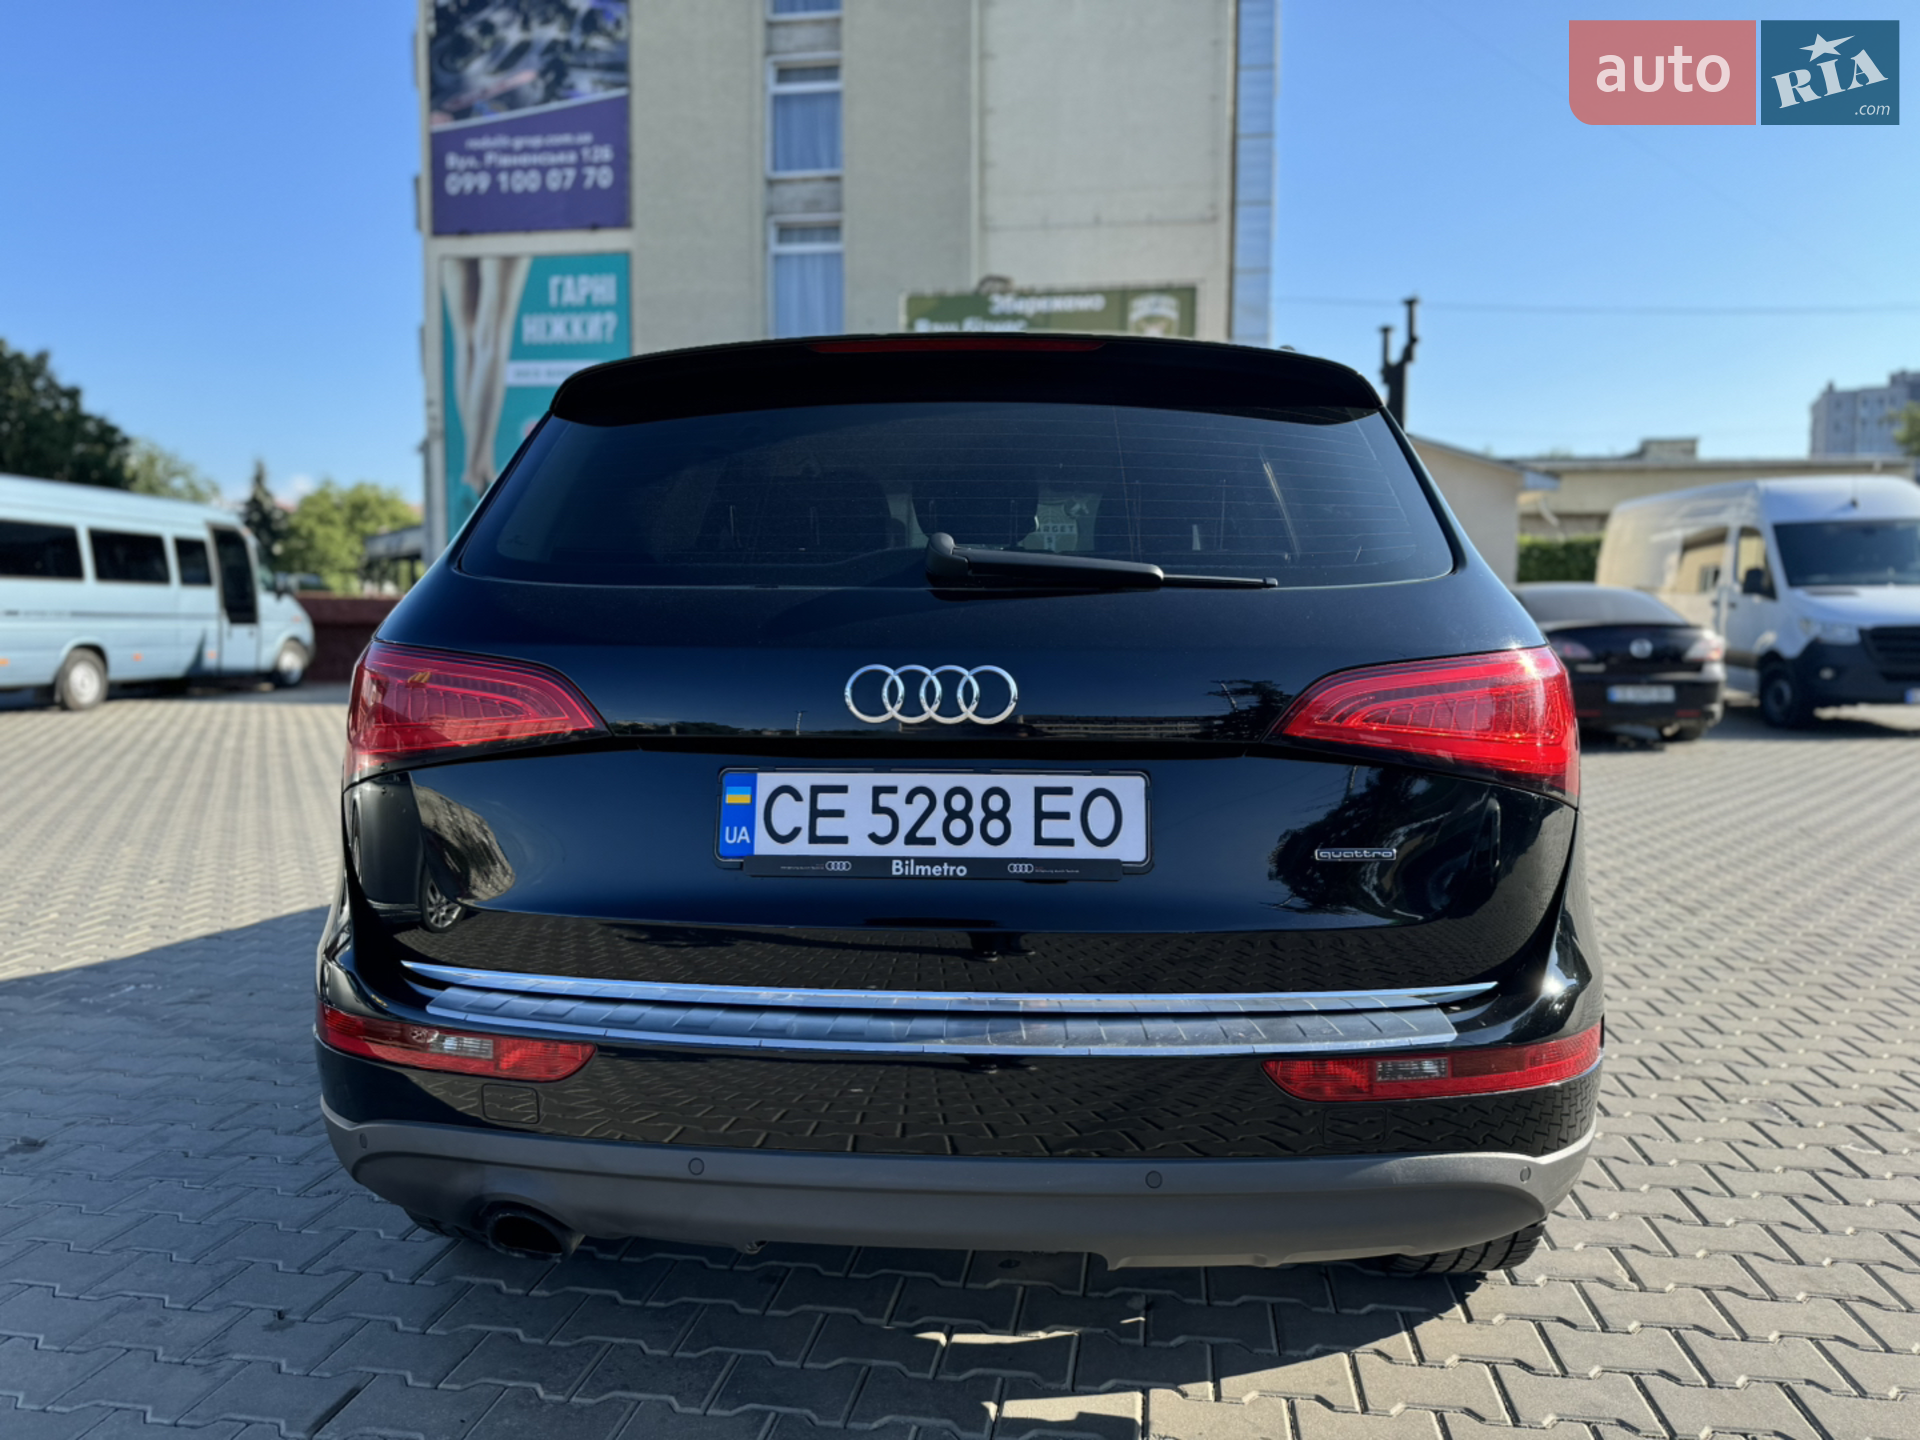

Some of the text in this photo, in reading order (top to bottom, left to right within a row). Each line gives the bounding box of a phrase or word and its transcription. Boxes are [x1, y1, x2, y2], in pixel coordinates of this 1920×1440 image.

[445, 164, 614, 196] 099 100 07 70
[548, 273, 617, 307] ГАРНІ
[522, 310, 618, 346] НІЖКИ?
[763, 784, 1123, 848] CE 5288 EO
[725, 826, 750, 844] UA
[891, 859, 968, 878] Bilmetro
[1319, 850, 1393, 859] quattro
